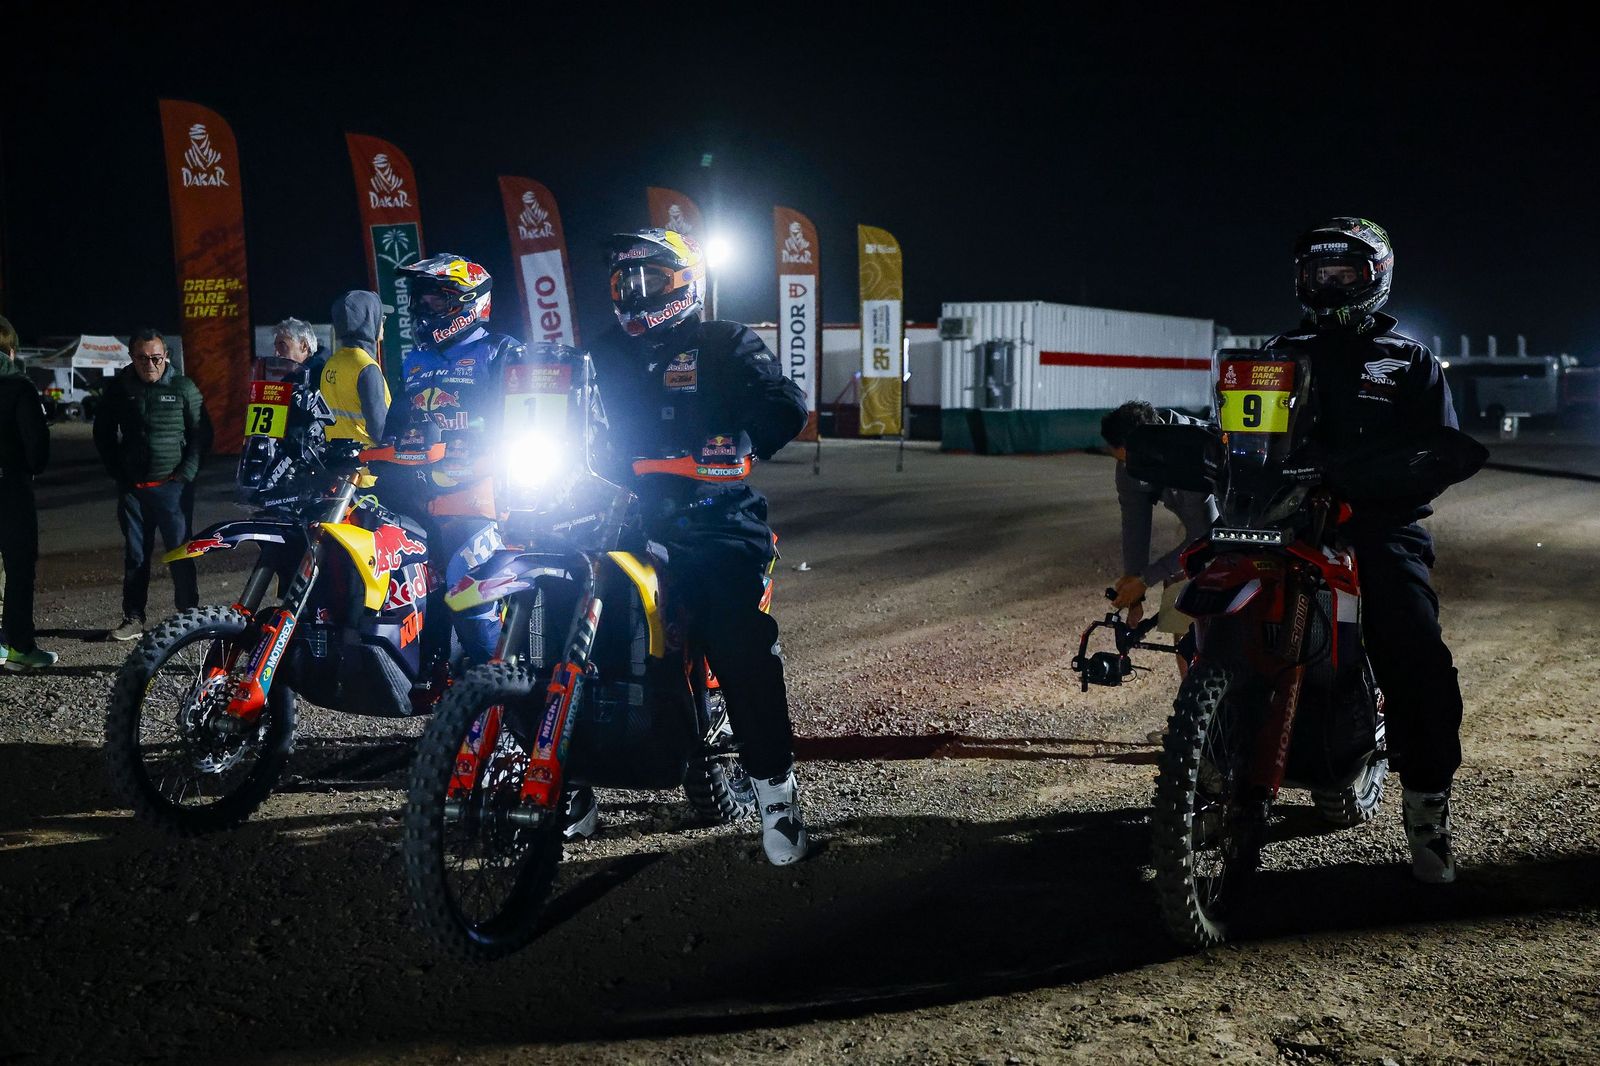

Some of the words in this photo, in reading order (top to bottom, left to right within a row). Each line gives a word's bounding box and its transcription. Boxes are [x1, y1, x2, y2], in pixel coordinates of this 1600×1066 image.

[182, 168, 229, 188] DAKAR
[369, 191, 411, 208] DAKAR
[518, 222, 555, 240] DAKAR
[1310, 242, 1348, 250] METHOD
[782, 250, 813, 264] DAKAR
[184, 278, 243, 291] DREAM.
[184, 292, 230, 304] DARE.
[395, 277, 412, 336] ARABIA
[185, 304, 219, 318] LIVE
[222, 304, 239, 317] IT.
[645, 304, 672, 328] Red
[671, 292, 695, 315] Bull
[432, 321, 459, 344] Red
[458, 308, 479, 329] Bull
[790, 304, 806, 384] TUDOR
[1252, 365, 1284, 373] DREAM.
[1360, 373, 1397, 386] HONDA
[251, 406, 274, 434] 73
[1243, 394, 1262, 428] 9
[708, 467, 744, 476] MOTOREX
[388, 562, 427, 611] Red
[400, 611, 424, 649] KTM
[270, 620, 295, 669] MOTOREX
